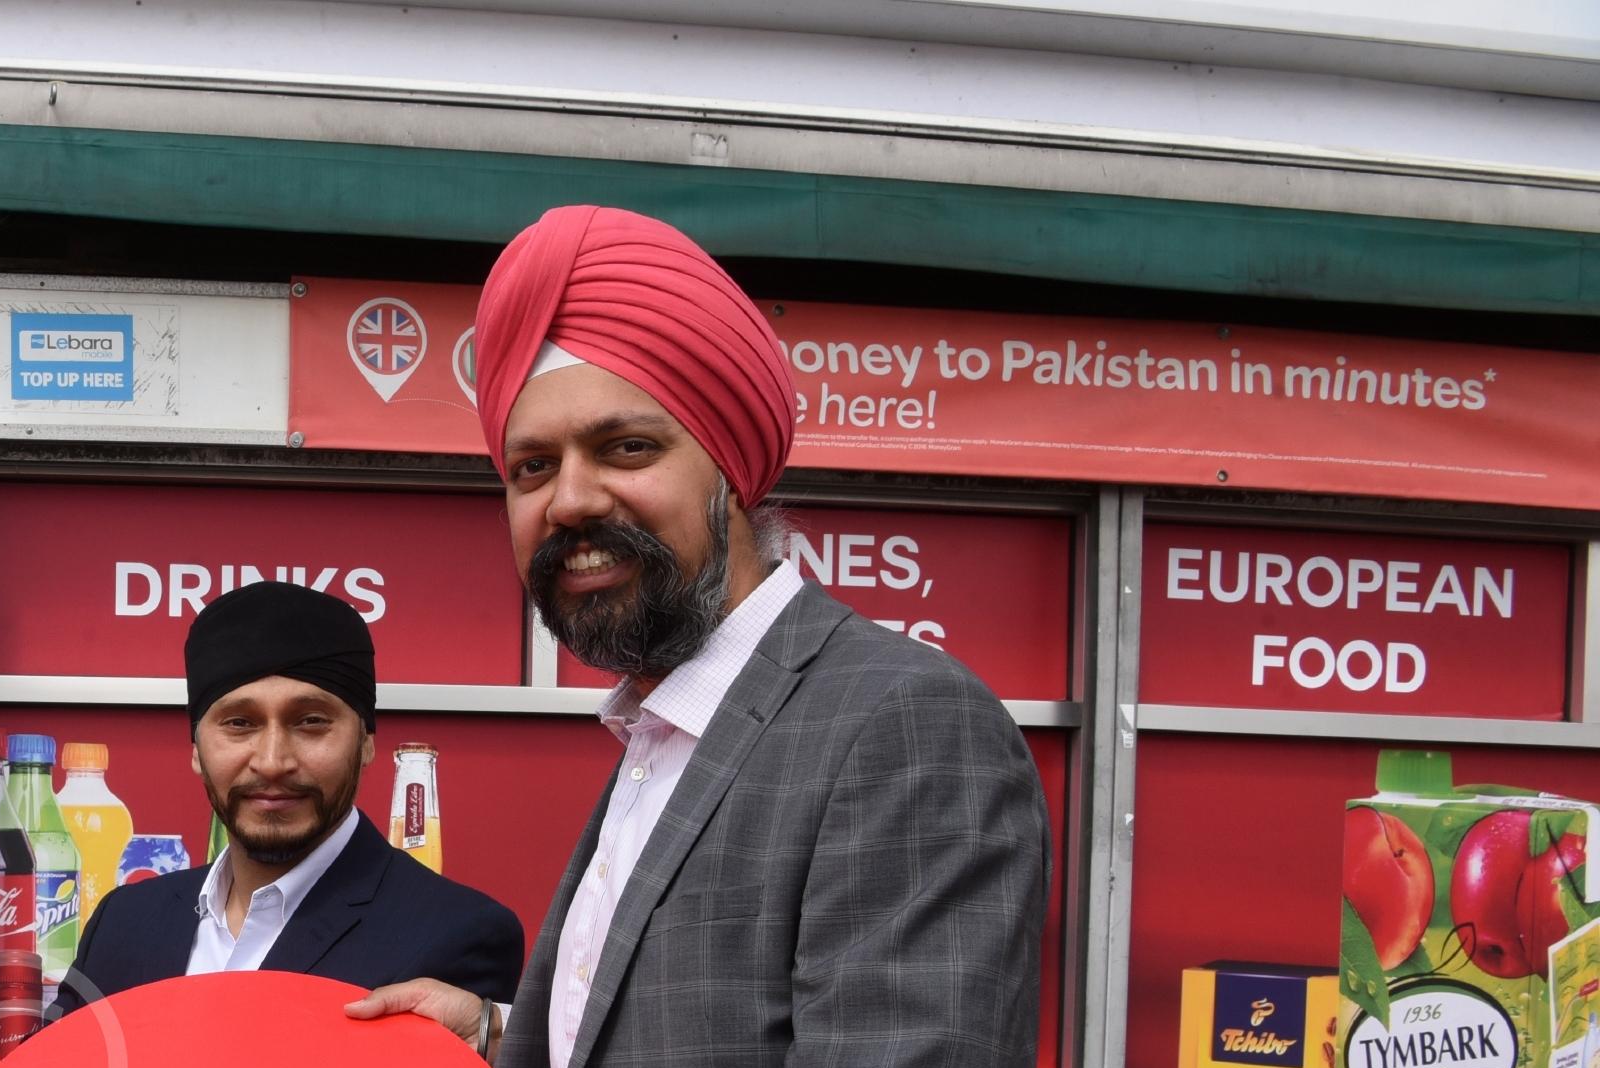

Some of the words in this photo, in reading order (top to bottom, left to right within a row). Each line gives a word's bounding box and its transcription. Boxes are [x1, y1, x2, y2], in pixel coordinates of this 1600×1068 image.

[47, 334, 113, 350] Lebara
[81, 351, 113, 359] mobile
[20, 372, 53, 388] TOP
[57, 372, 80, 388] UP
[83, 372, 125, 388] HERE
[933, 339, 991, 381] to
[1002, 339, 1218, 392] Pakistan
[1231, 348, 1272, 396] in
[818, 382, 937, 430] here!
[788, 532, 933, 598] NES,
[1167, 547, 1514, 620] EUROPEAN
[115, 561, 386, 624] DRIS
[1251, 634, 1427, 694] FOOD
[1403, 1004, 1443, 1024] 1936
[1220, 1028, 1297, 1055] Tchibo
